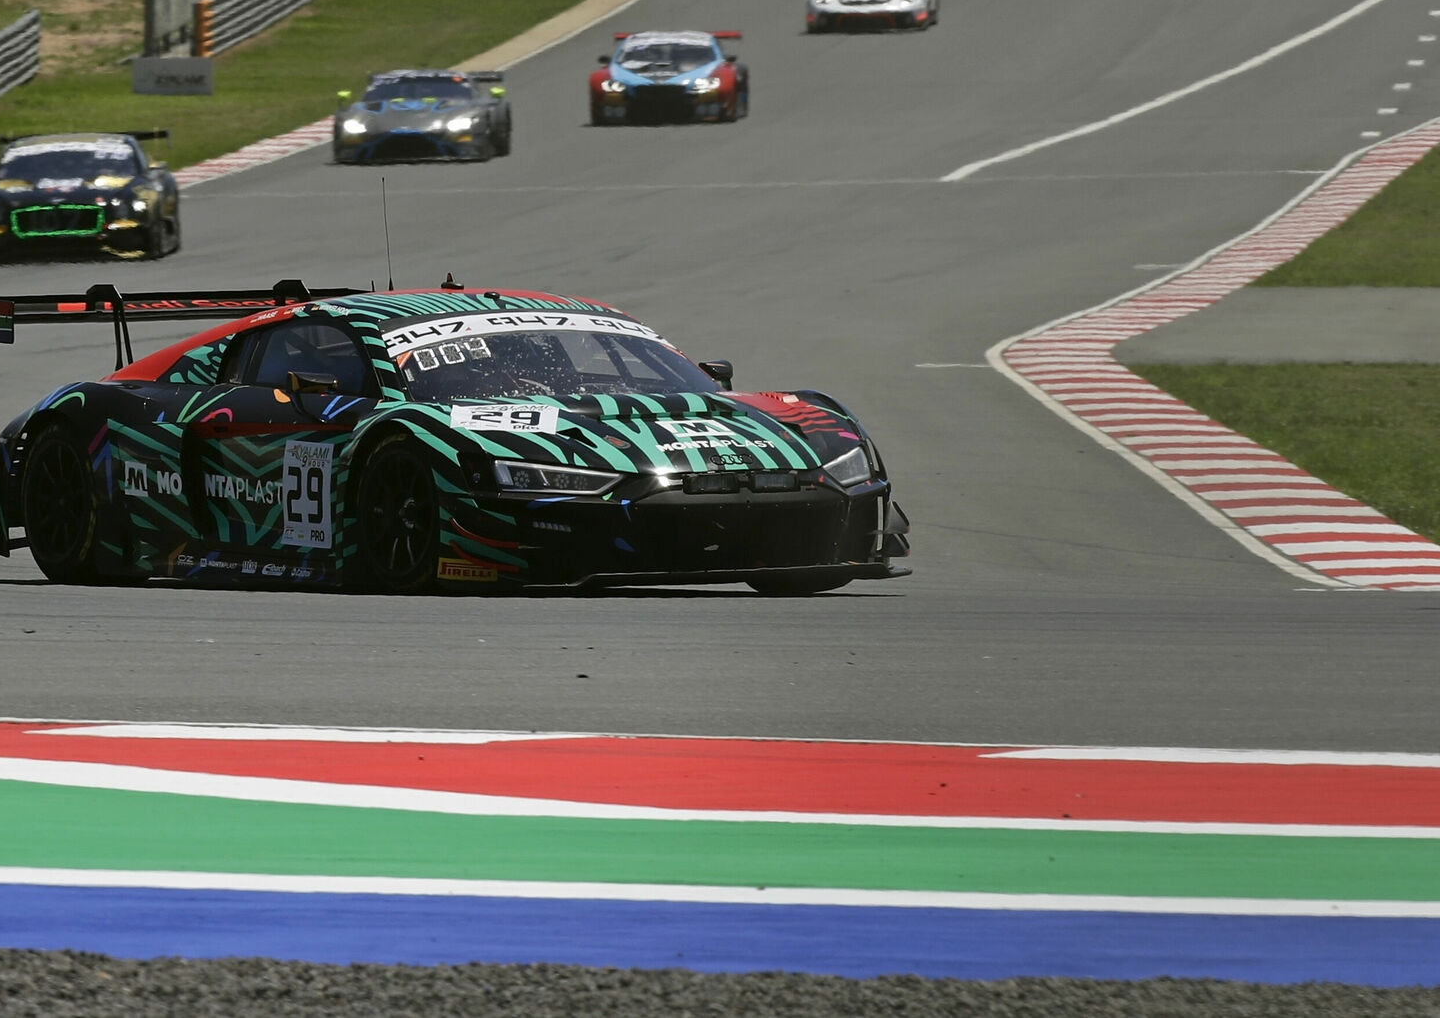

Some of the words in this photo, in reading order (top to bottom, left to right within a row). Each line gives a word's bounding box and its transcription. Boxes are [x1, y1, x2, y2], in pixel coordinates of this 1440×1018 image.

[486, 315, 569, 327] 947
[385, 320, 465, 349] 947
[471, 411, 541, 426] 29
[288, 444, 330, 460] KYALAMI
[655, 439, 776, 453] MONTAPLAST
[286, 466, 324, 524] 29
[310, 529, 325, 542] PRO
[441, 562, 497, 578] PIRELLI
